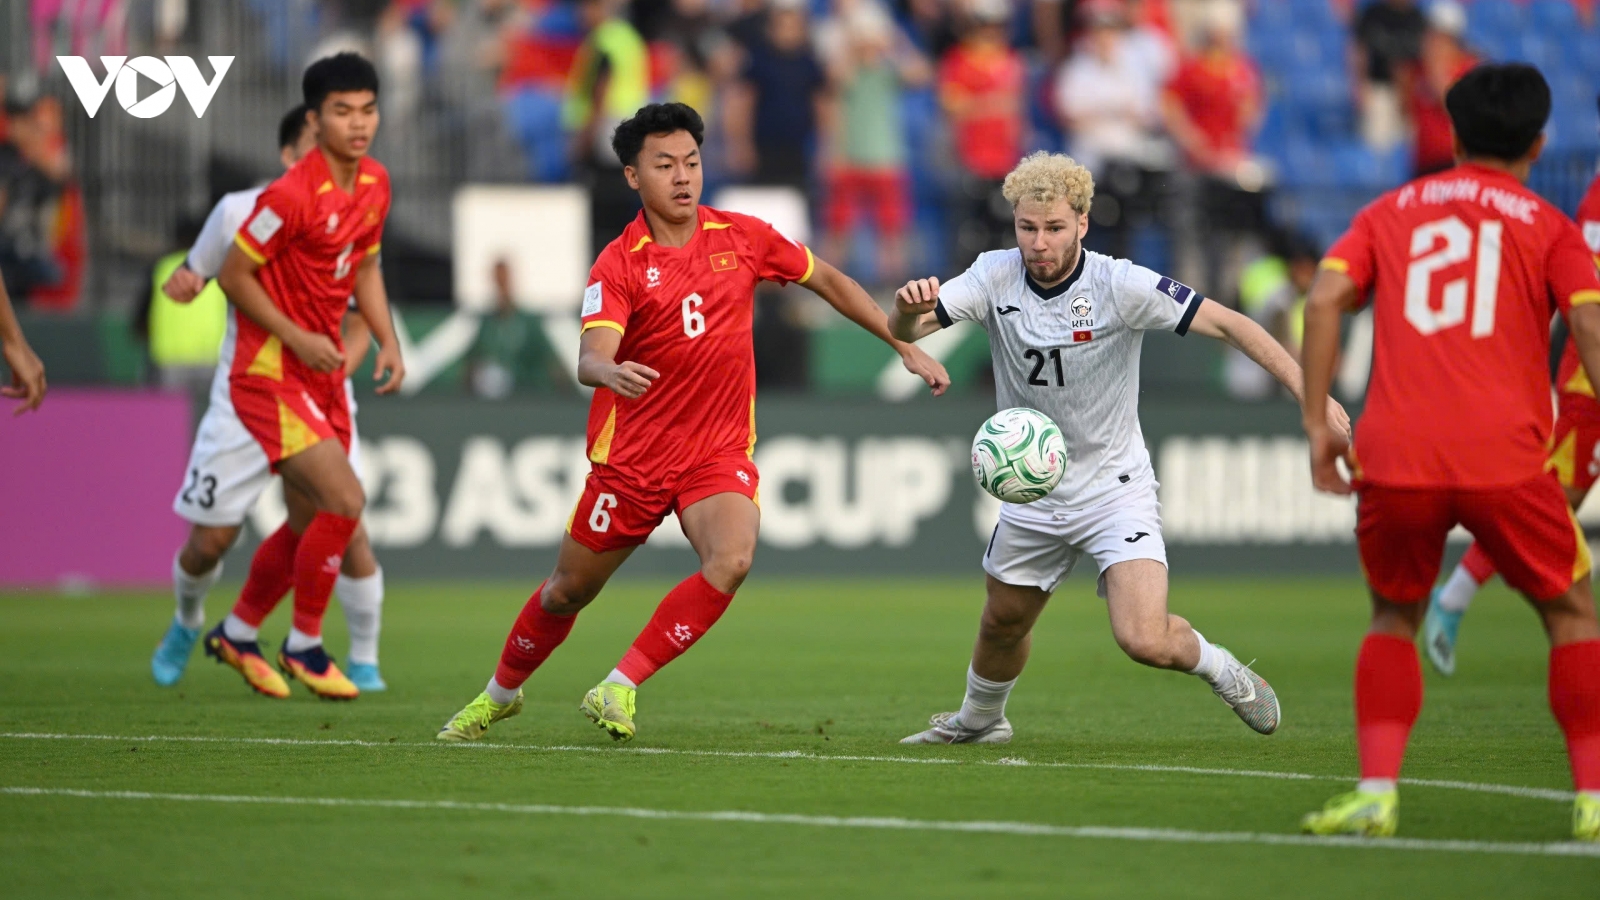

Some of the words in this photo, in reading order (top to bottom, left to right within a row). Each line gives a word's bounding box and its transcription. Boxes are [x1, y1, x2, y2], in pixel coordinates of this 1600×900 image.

[1403, 215, 1504, 339] 21
[681, 292, 706, 339] 6
[1071, 319, 1094, 328] KFU
[1023, 348, 1065, 387] 21
[182, 468, 217, 509] 23
[588, 493, 618, 533] 6
